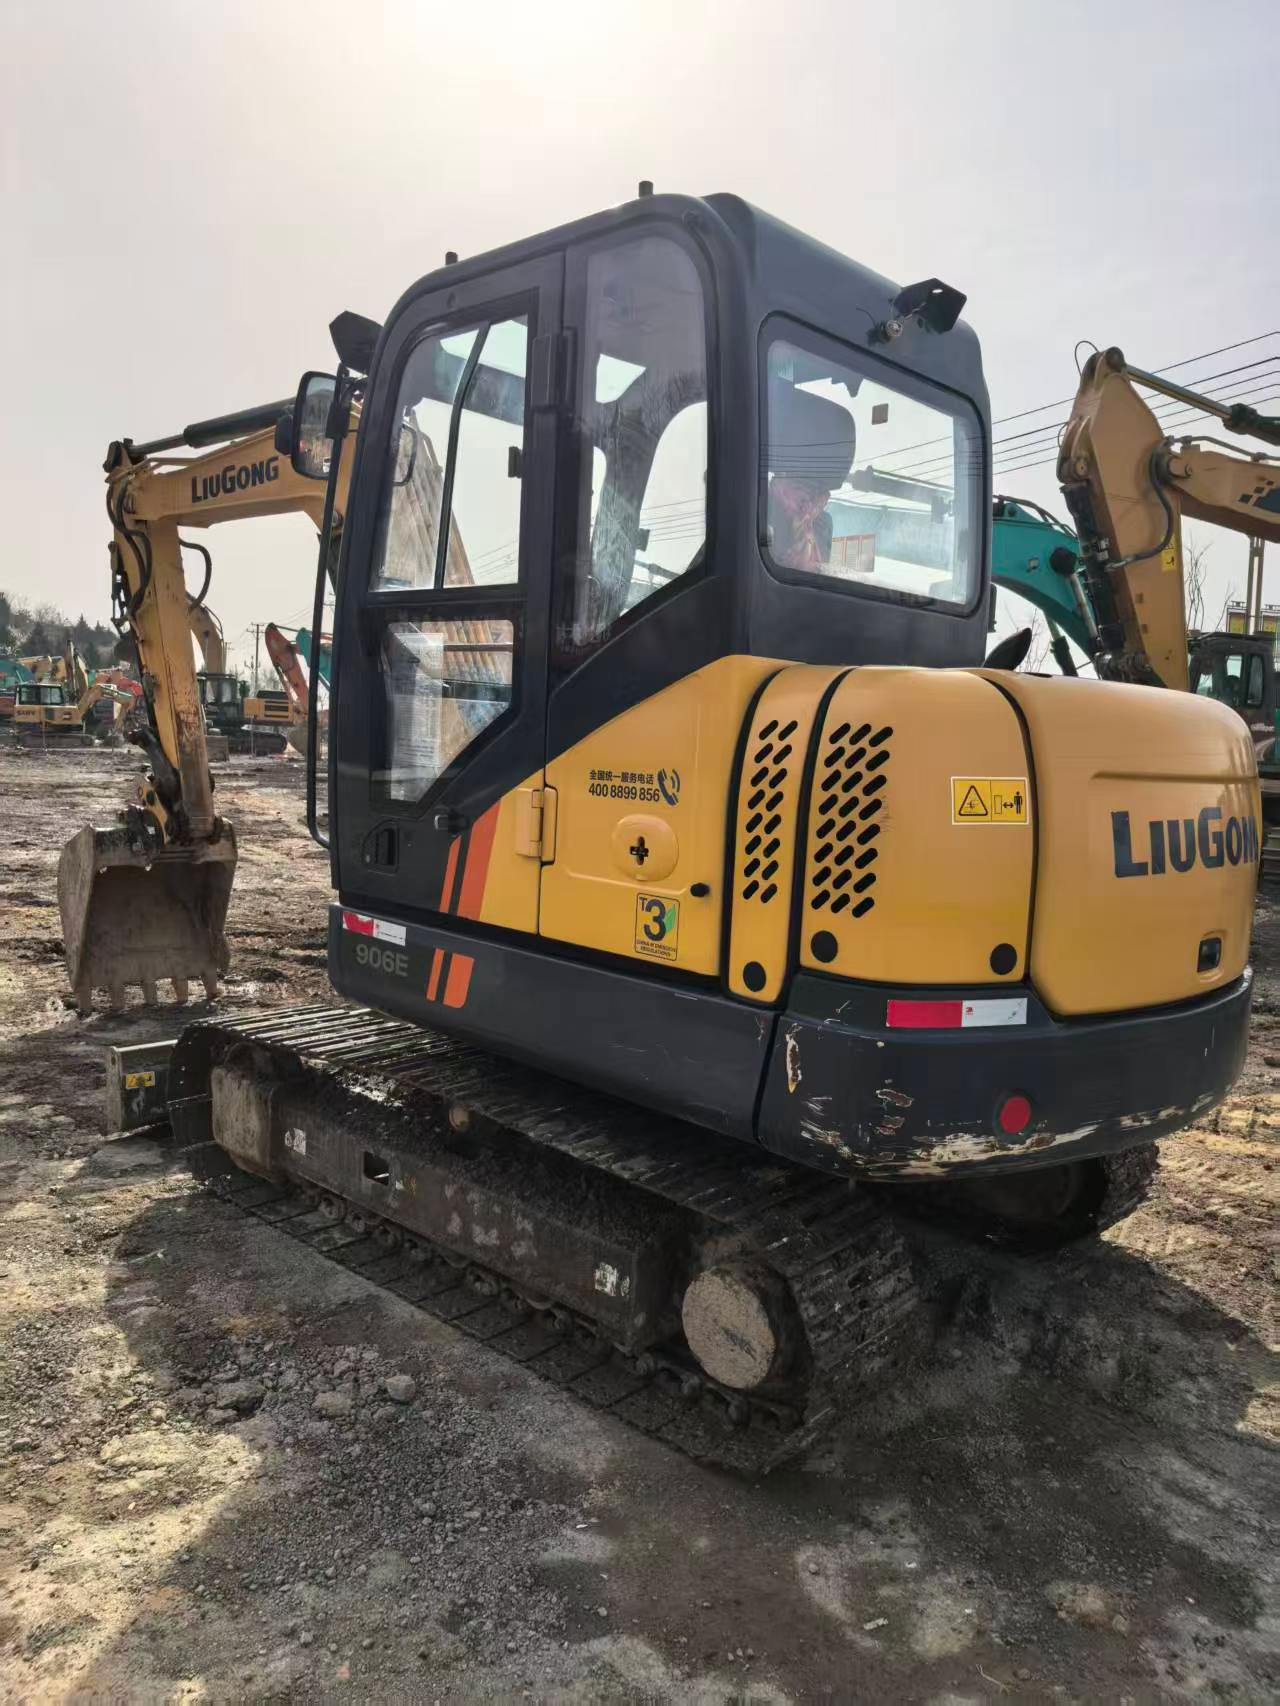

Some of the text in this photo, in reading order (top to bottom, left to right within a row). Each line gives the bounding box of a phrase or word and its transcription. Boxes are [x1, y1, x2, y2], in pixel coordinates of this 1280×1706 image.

[589, 769, 655, 785] 全国统一服务电话
[588, 782, 660, 802] 400 8899 856
[1111, 807, 1258, 878] LIUGON
[355, 944, 408, 977] 906E
